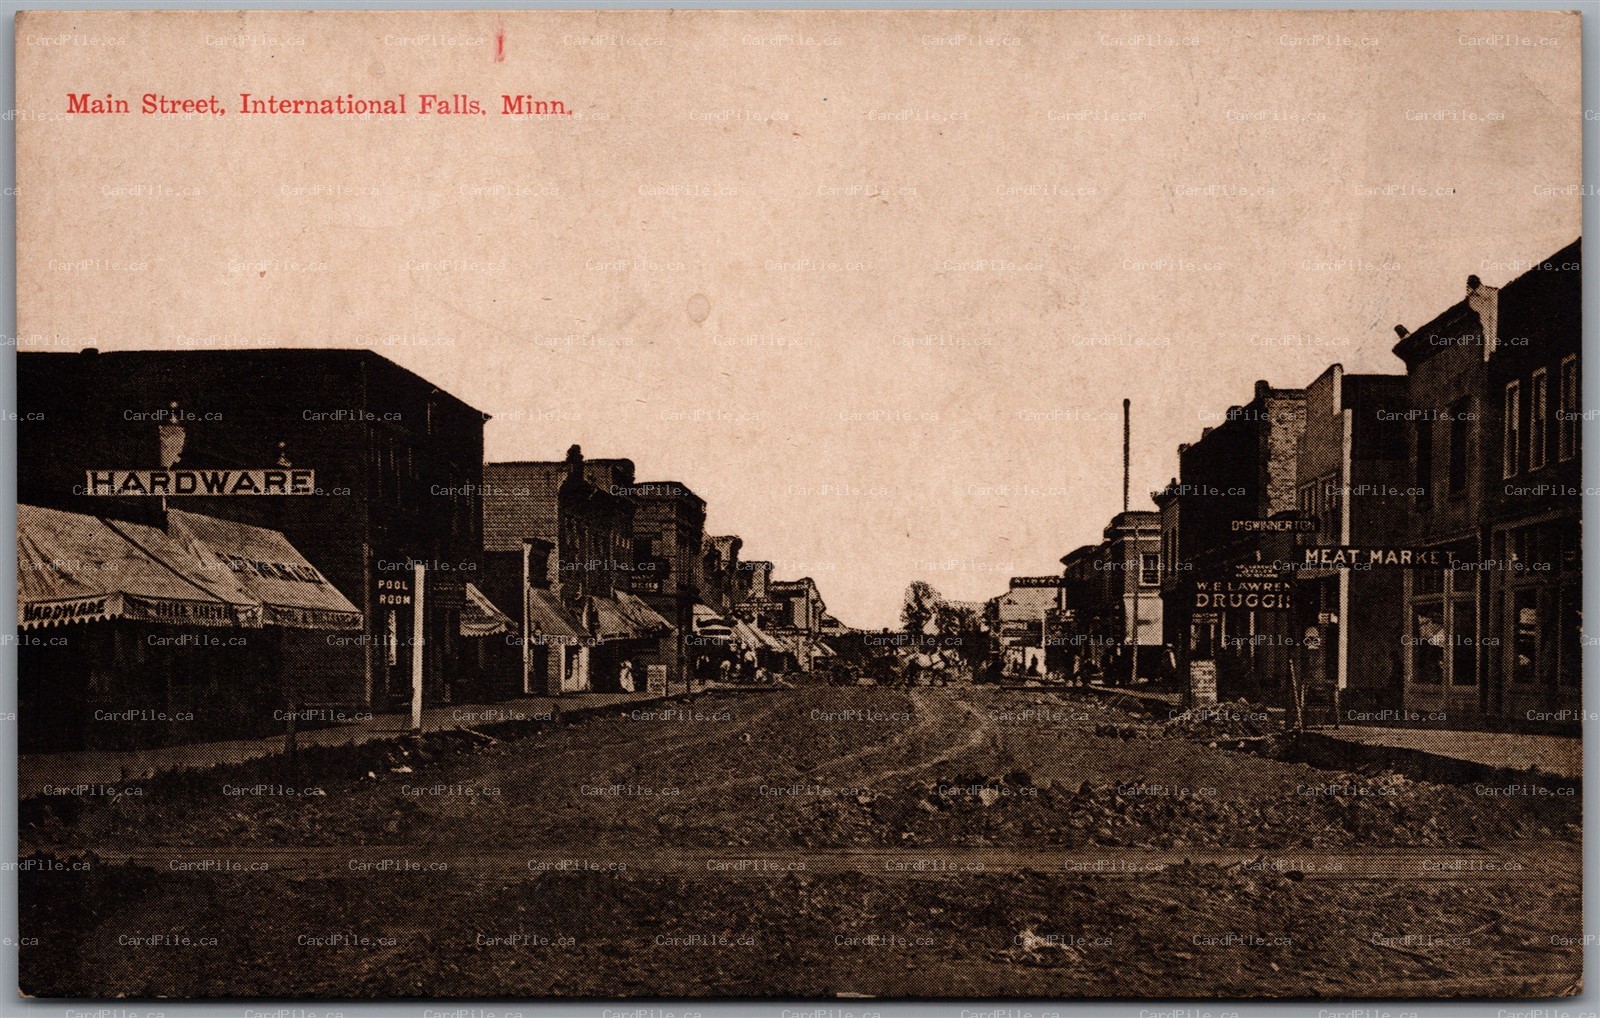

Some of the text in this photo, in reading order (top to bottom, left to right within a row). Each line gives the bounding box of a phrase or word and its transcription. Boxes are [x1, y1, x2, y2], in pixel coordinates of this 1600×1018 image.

[91, 471, 311, 494] HARDWARE
[1305, 549, 1456, 564] MEAT MARKET
[378, 580, 408, 590] POOL
[379, 593, 410, 604] ROOM
[24, 600, 106, 621] HARDWARE
